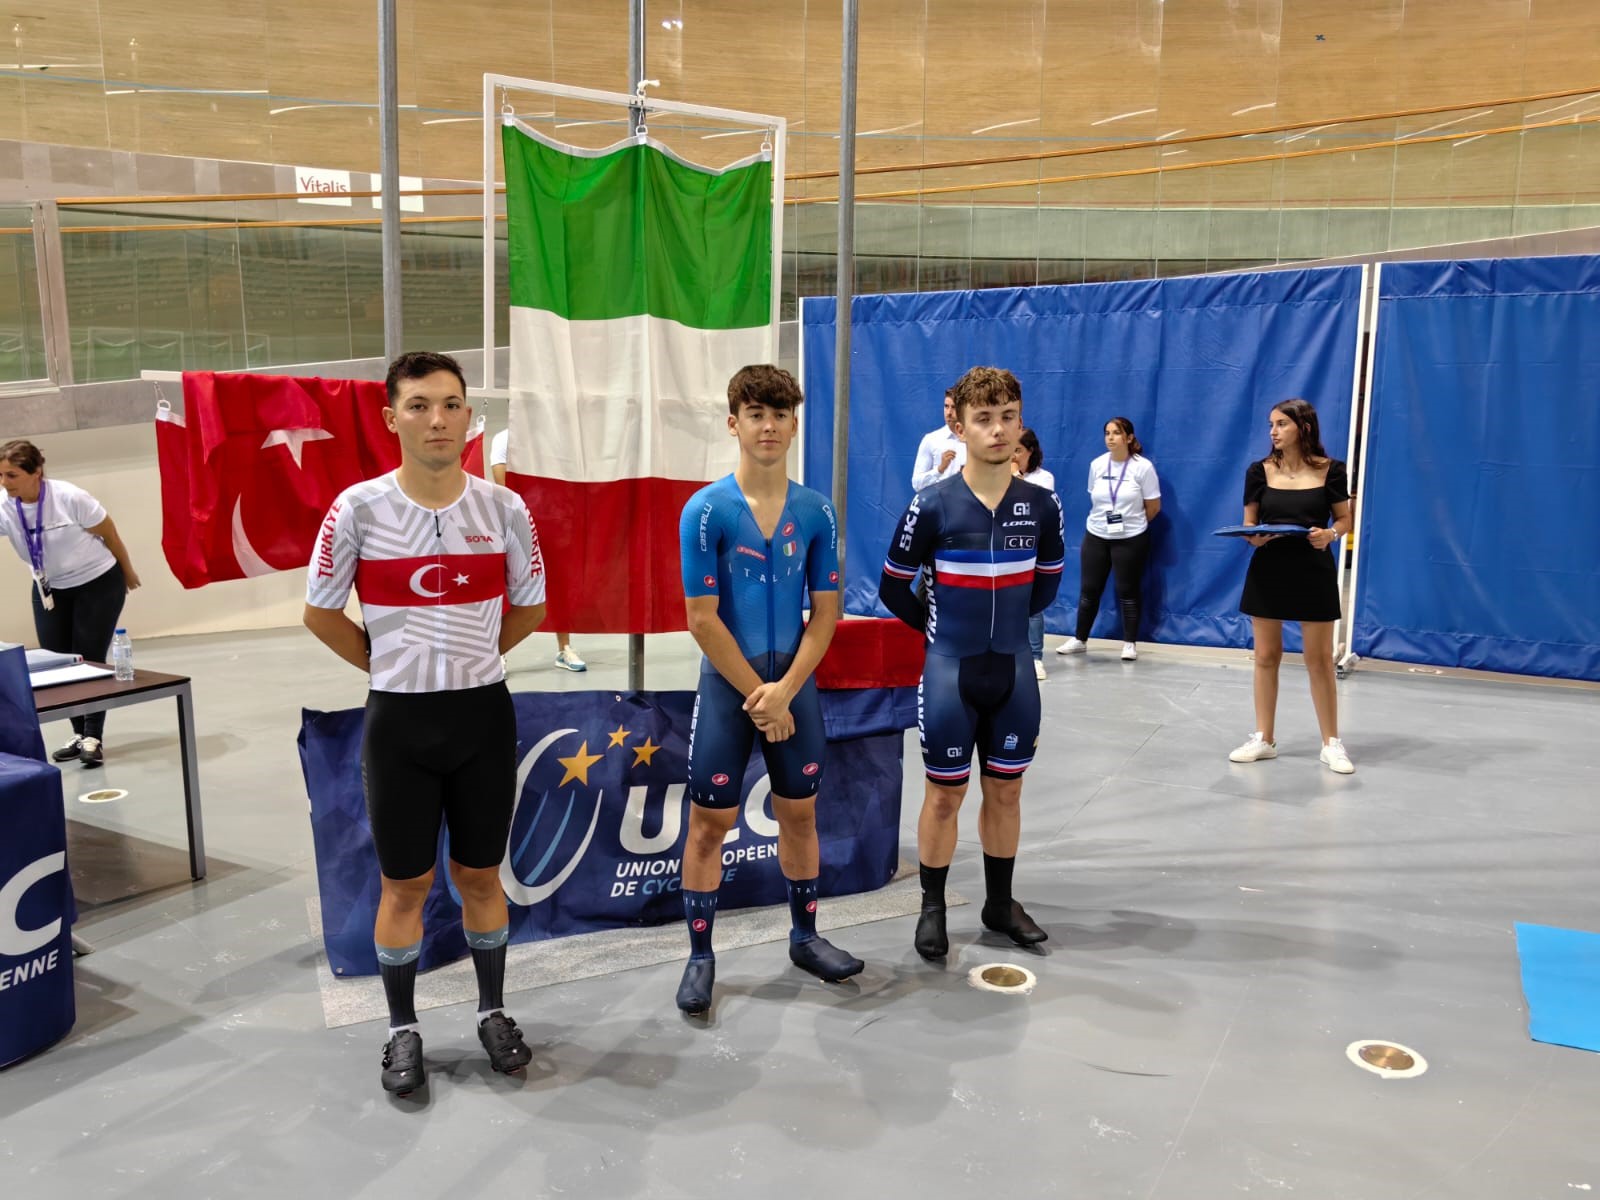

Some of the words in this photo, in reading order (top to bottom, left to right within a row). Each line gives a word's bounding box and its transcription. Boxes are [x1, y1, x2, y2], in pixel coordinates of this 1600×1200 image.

[300, 175, 347, 193] Vitalis
[616, 859, 680, 877] UNION
[610, 881, 638, 897] DE
